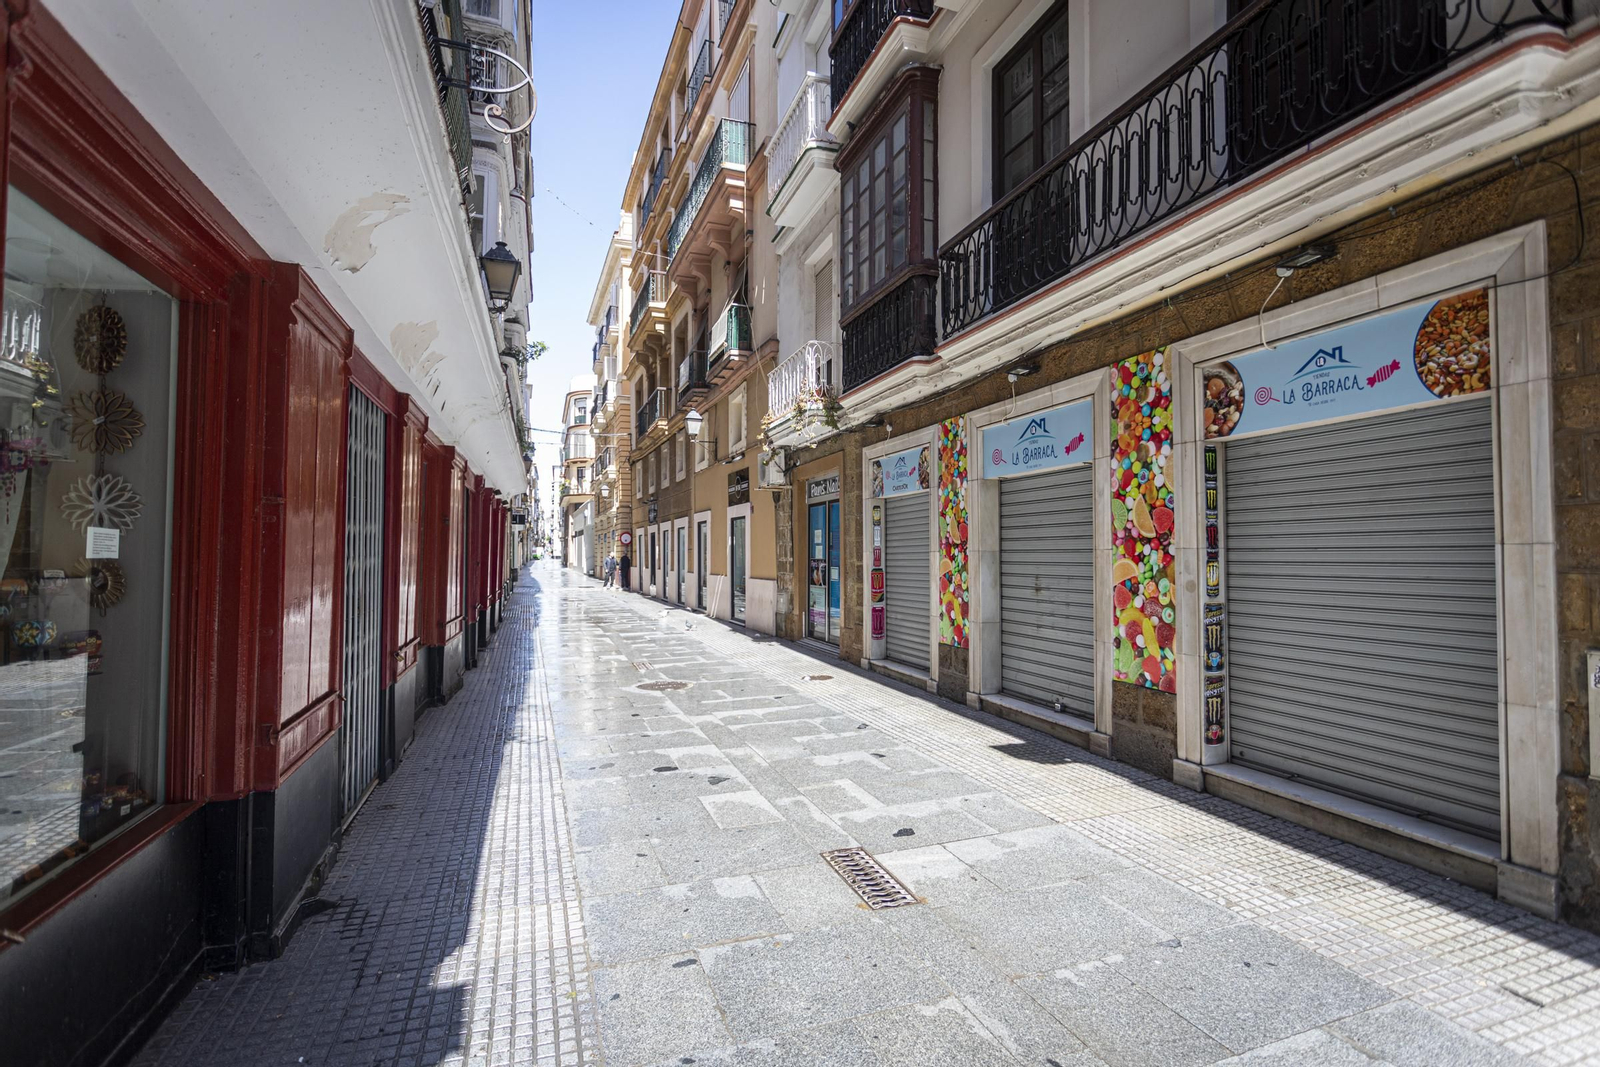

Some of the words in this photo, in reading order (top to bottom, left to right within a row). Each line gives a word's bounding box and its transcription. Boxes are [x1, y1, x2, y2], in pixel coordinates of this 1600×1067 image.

[1283, 389, 1296, 405] LA
[1302, 374, 1364, 401] BARRACA
[1012, 452, 1020, 466] LA
[1022, 444, 1058, 464] BARRACA
